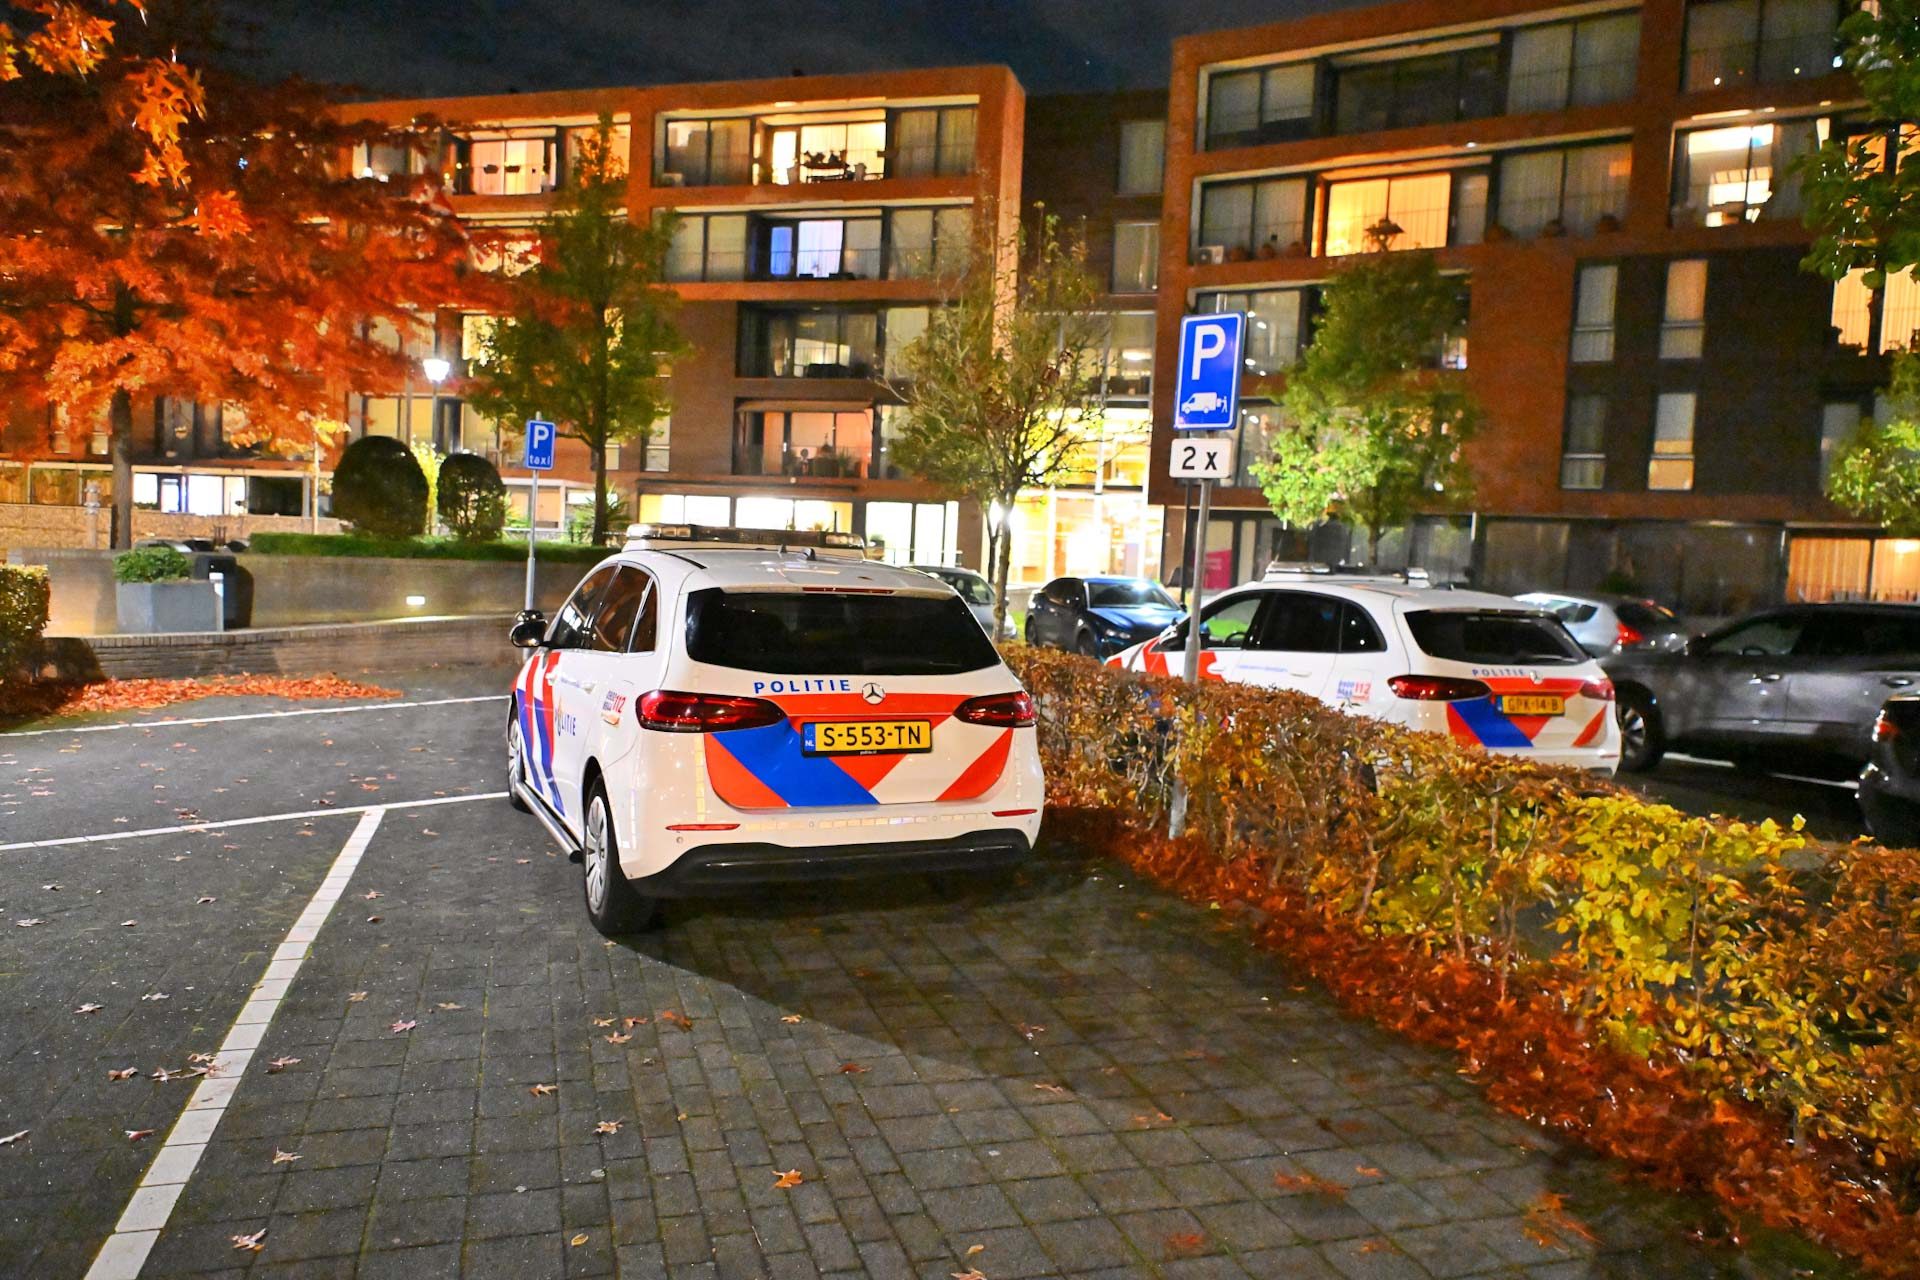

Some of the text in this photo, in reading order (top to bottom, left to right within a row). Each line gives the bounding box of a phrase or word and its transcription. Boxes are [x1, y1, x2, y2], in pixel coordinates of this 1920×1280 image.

[1191, 324, 1226, 381] P
[533, 424, 550, 449] P
[529, 454, 551, 465] taxi
[1181, 446, 1196, 471] 2
[1472, 668, 1524, 677] POLITIE
[754, 679, 851, 694] POLITIE
[612, 694, 627, 714] 112
[804, 739, 815, 747] NL
[823, 725, 921, 747] S-553-TN
